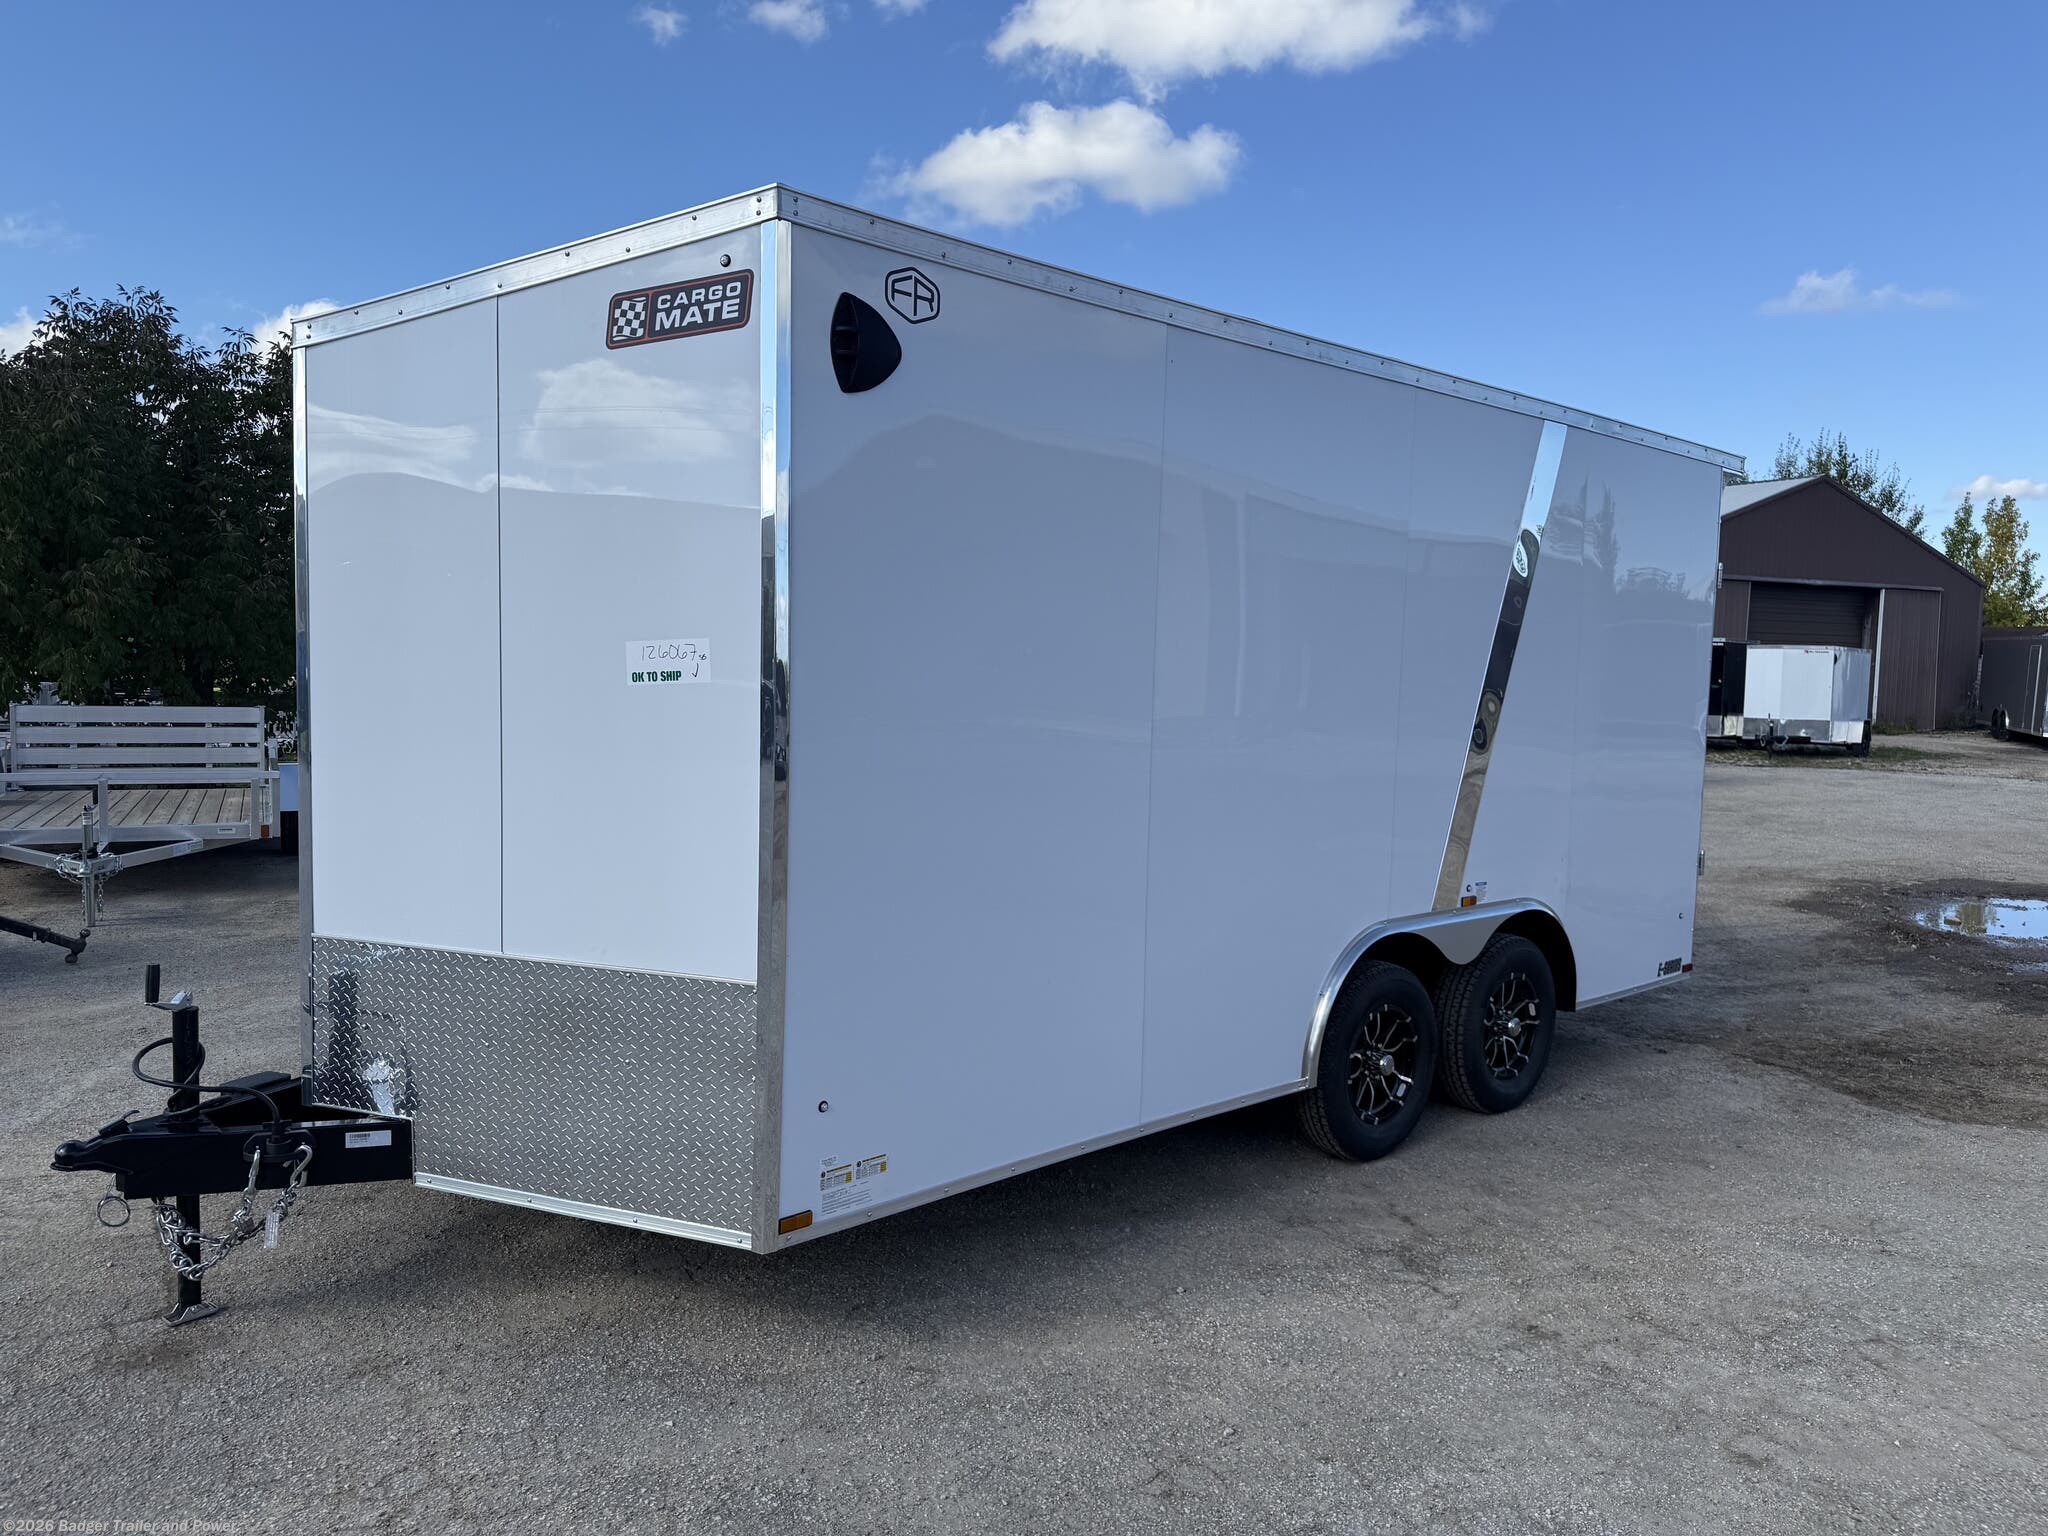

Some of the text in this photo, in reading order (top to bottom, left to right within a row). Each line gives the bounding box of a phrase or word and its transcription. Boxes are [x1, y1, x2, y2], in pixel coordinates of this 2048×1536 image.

[657, 281, 742, 309] CARGO
[655, 298, 740, 331] MATE
[641, 643, 697, 661] 126067
[631, 670, 682, 683] OK TO SHIP
